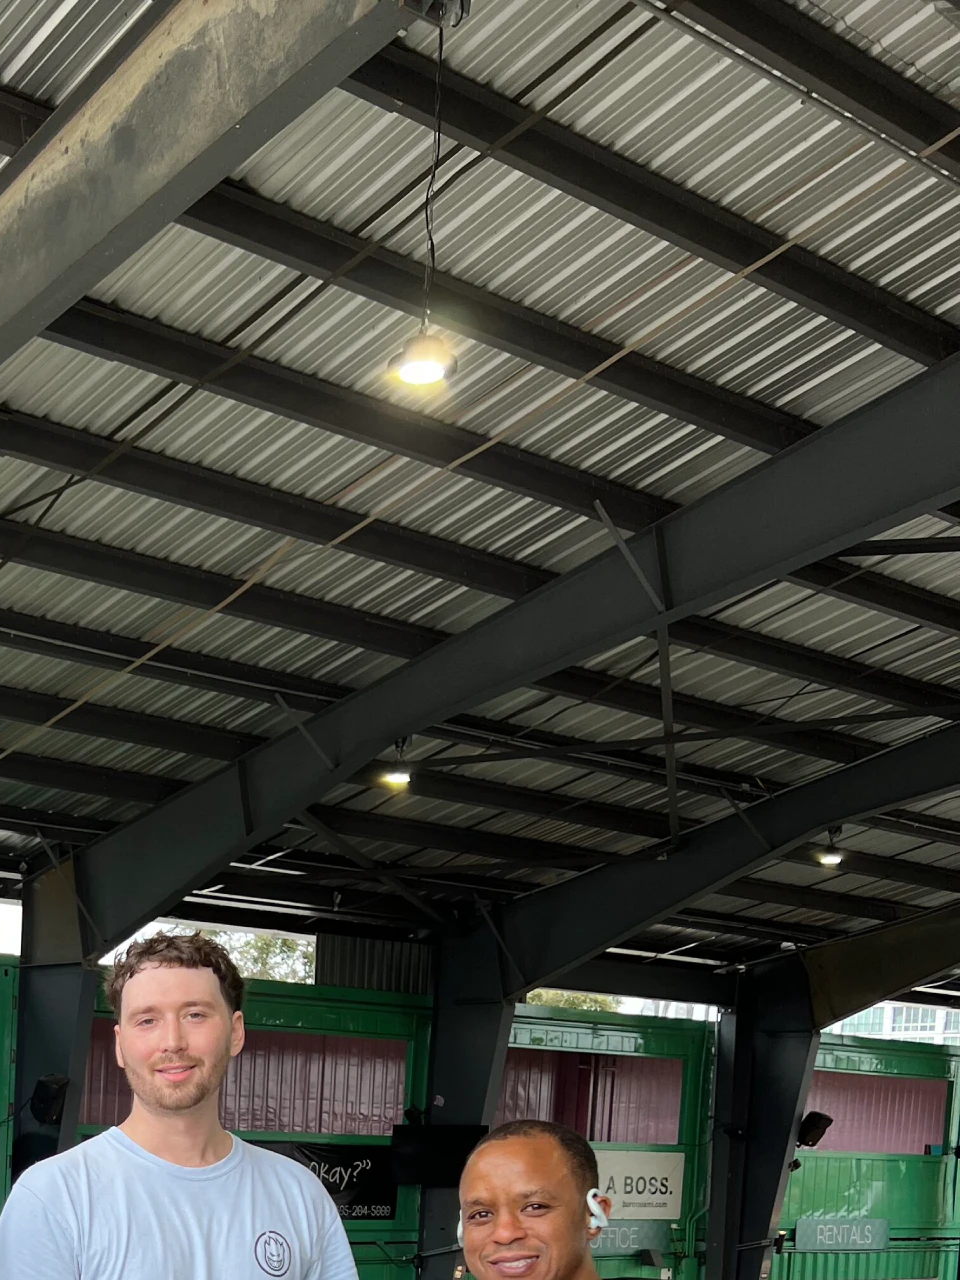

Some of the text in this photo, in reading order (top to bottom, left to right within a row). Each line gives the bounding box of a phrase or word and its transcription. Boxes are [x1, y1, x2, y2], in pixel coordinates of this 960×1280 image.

[605, 1175, 673, 1195] A BOSS.
[817, 1225, 872, 1245] RENTALS
